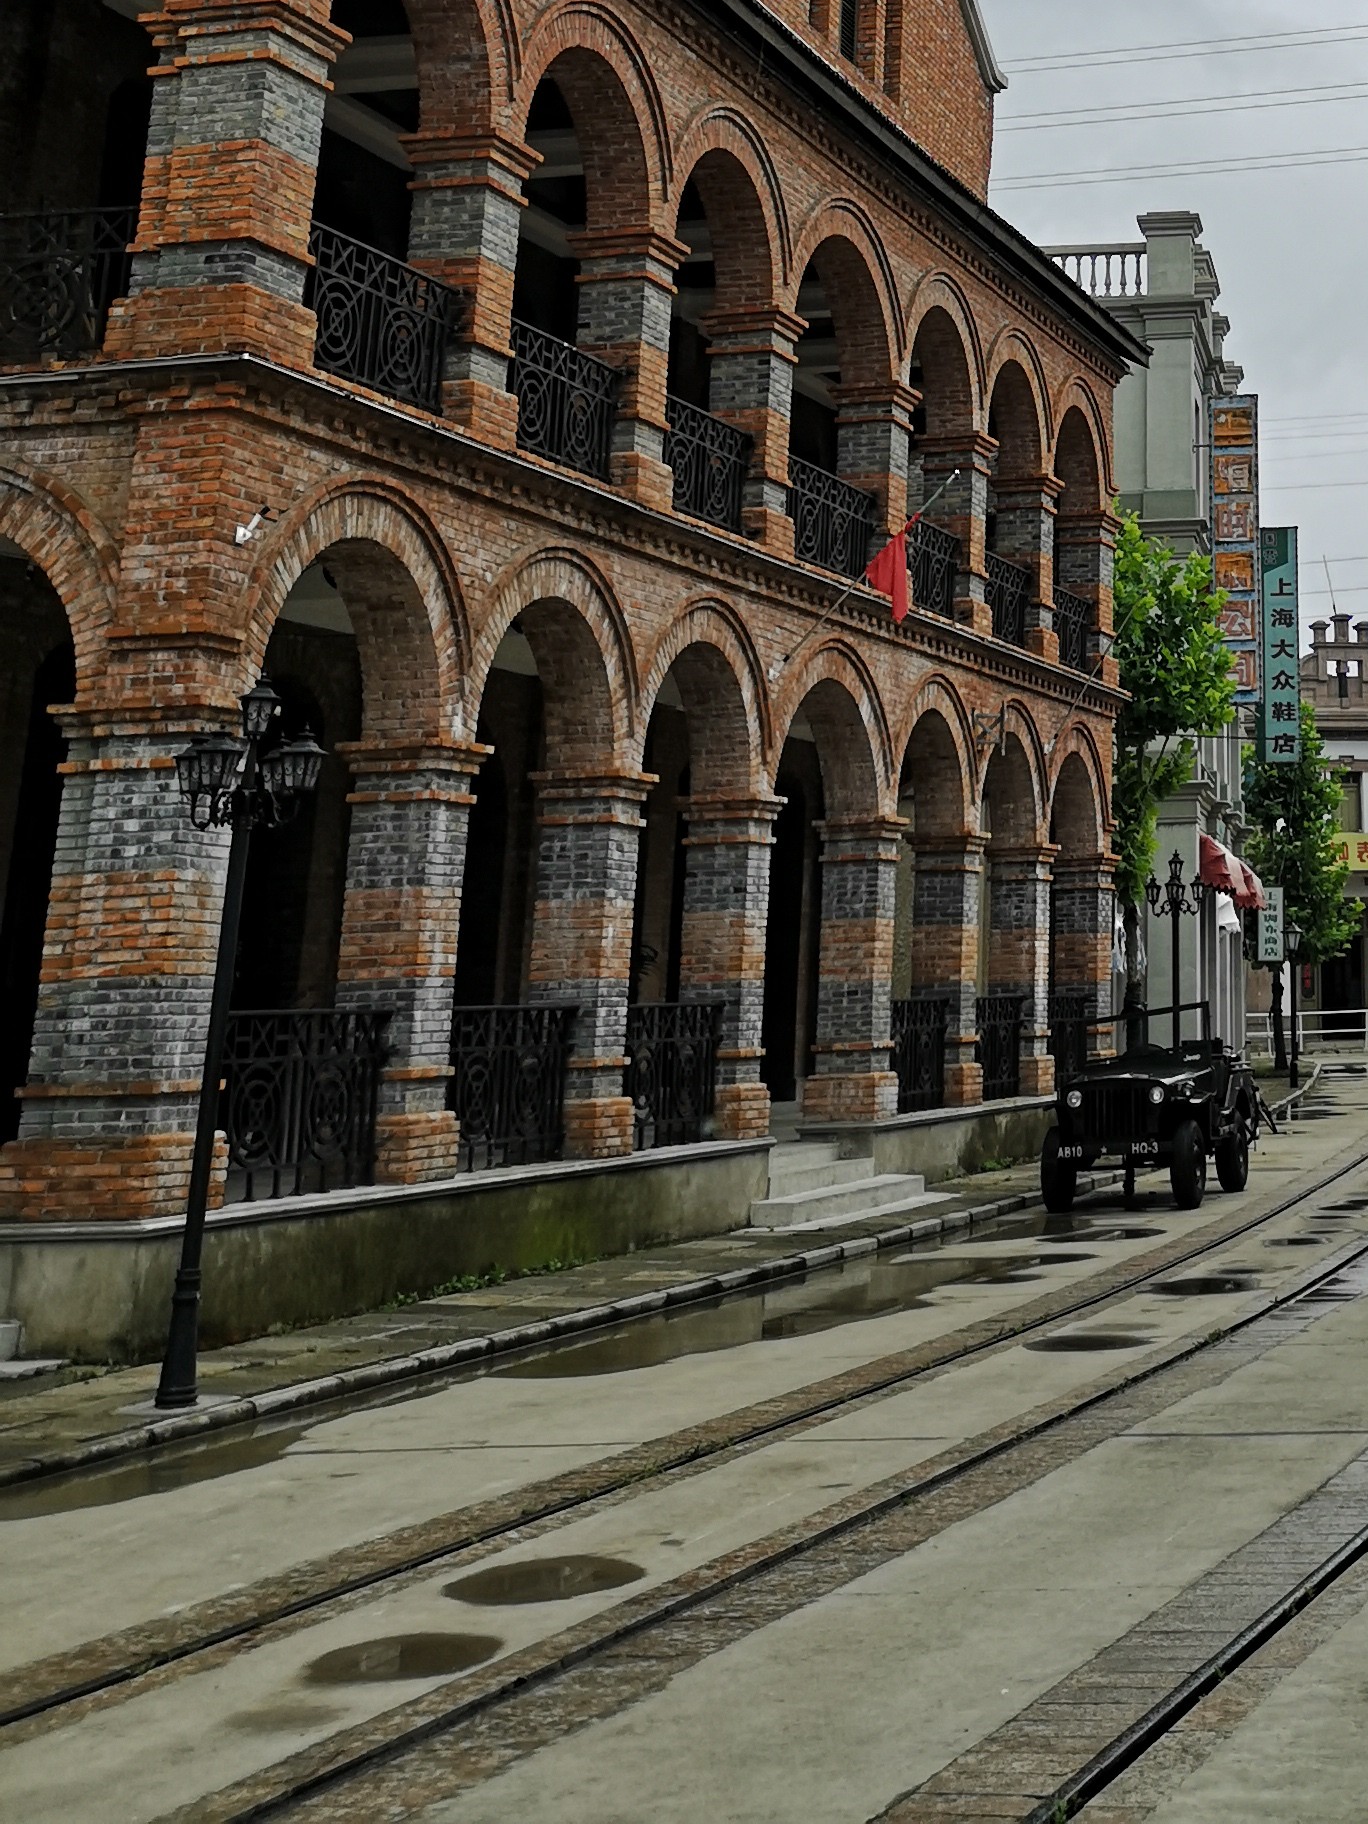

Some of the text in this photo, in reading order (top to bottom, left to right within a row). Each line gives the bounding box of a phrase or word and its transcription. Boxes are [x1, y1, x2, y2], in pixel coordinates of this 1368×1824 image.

[1270, 577, 1297, 755] 上海大众鞋店
[1057, 1145, 1083, 1159] AB10
[1131, 1141, 1159, 1154] HQ-3
